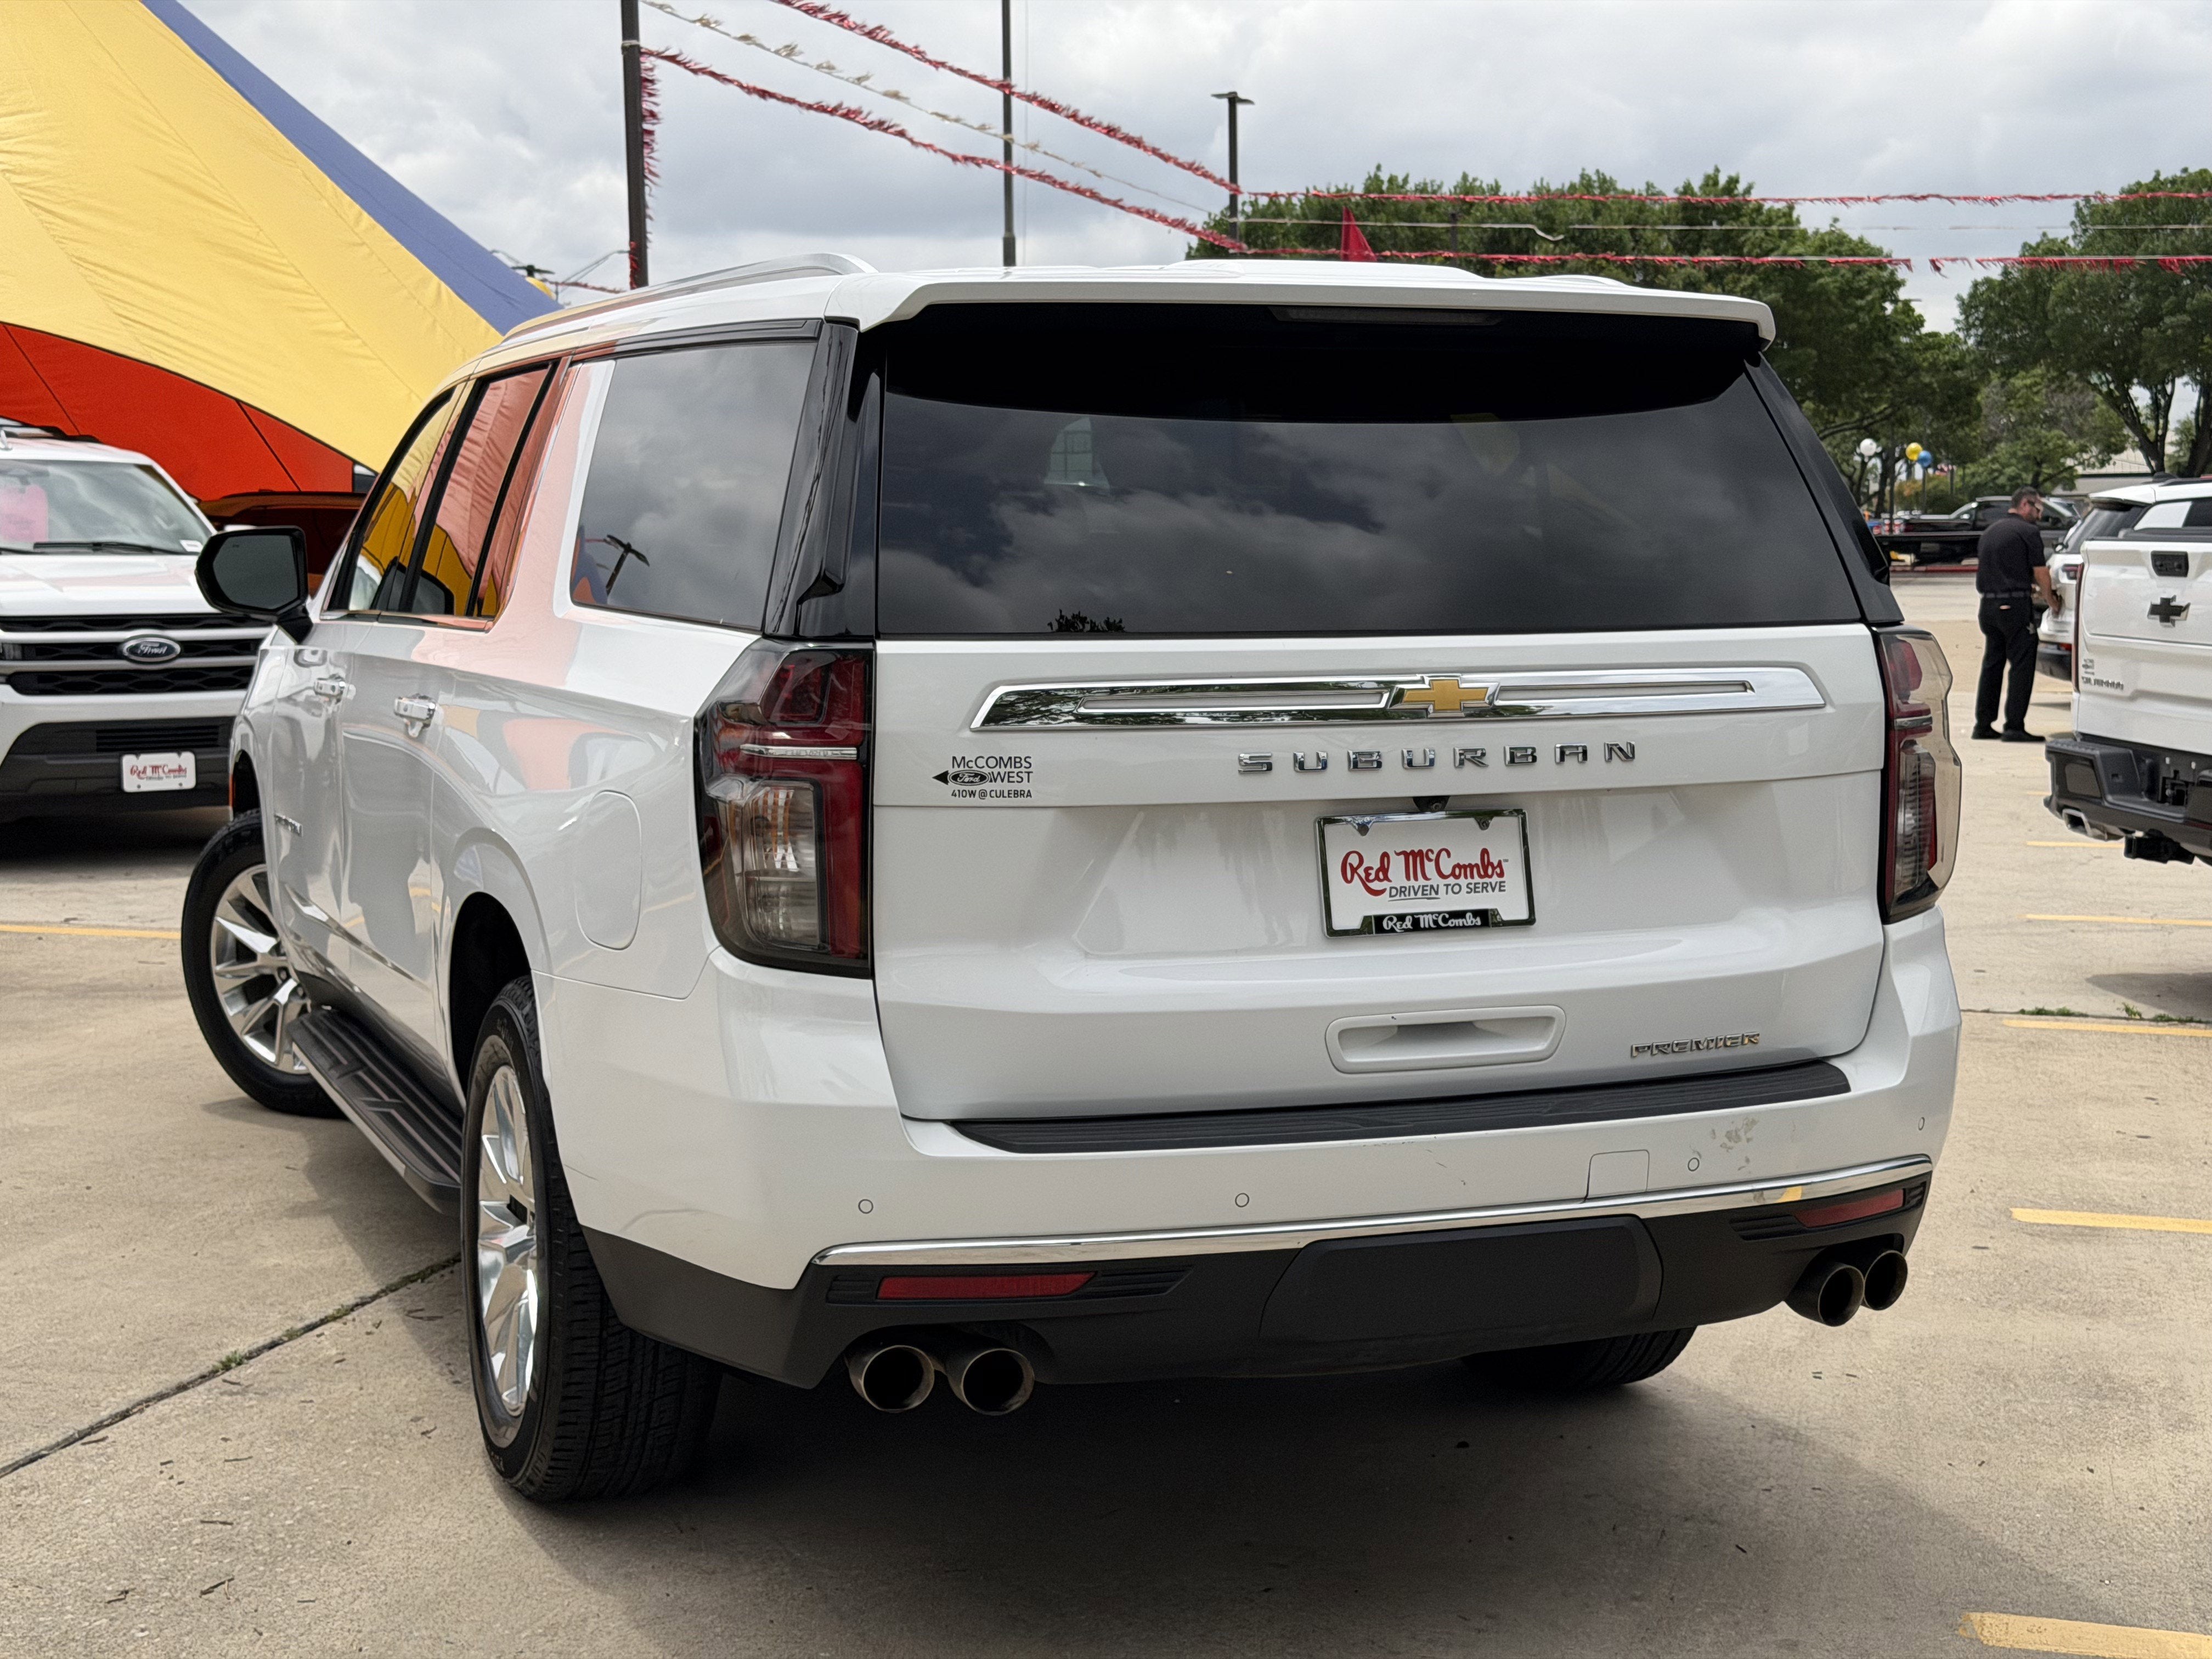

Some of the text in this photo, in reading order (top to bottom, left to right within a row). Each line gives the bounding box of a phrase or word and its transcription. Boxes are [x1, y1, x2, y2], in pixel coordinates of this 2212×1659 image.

[952, 755, 1032, 769] McCOMBS
[1238, 740, 1636, 774] SUBURBAN
[957, 771, 1034, 783] Ford WEST
[951, 789, 1032, 800] 410W @ CULEBRA
[1341, 848, 1505, 896] Red McCombs
[1389, 881, 1506, 898] DRIVEN TO SERVE
[1383, 912, 1481, 932] Red McCombs
[1630, 1032, 1760, 1058] PREMIER
